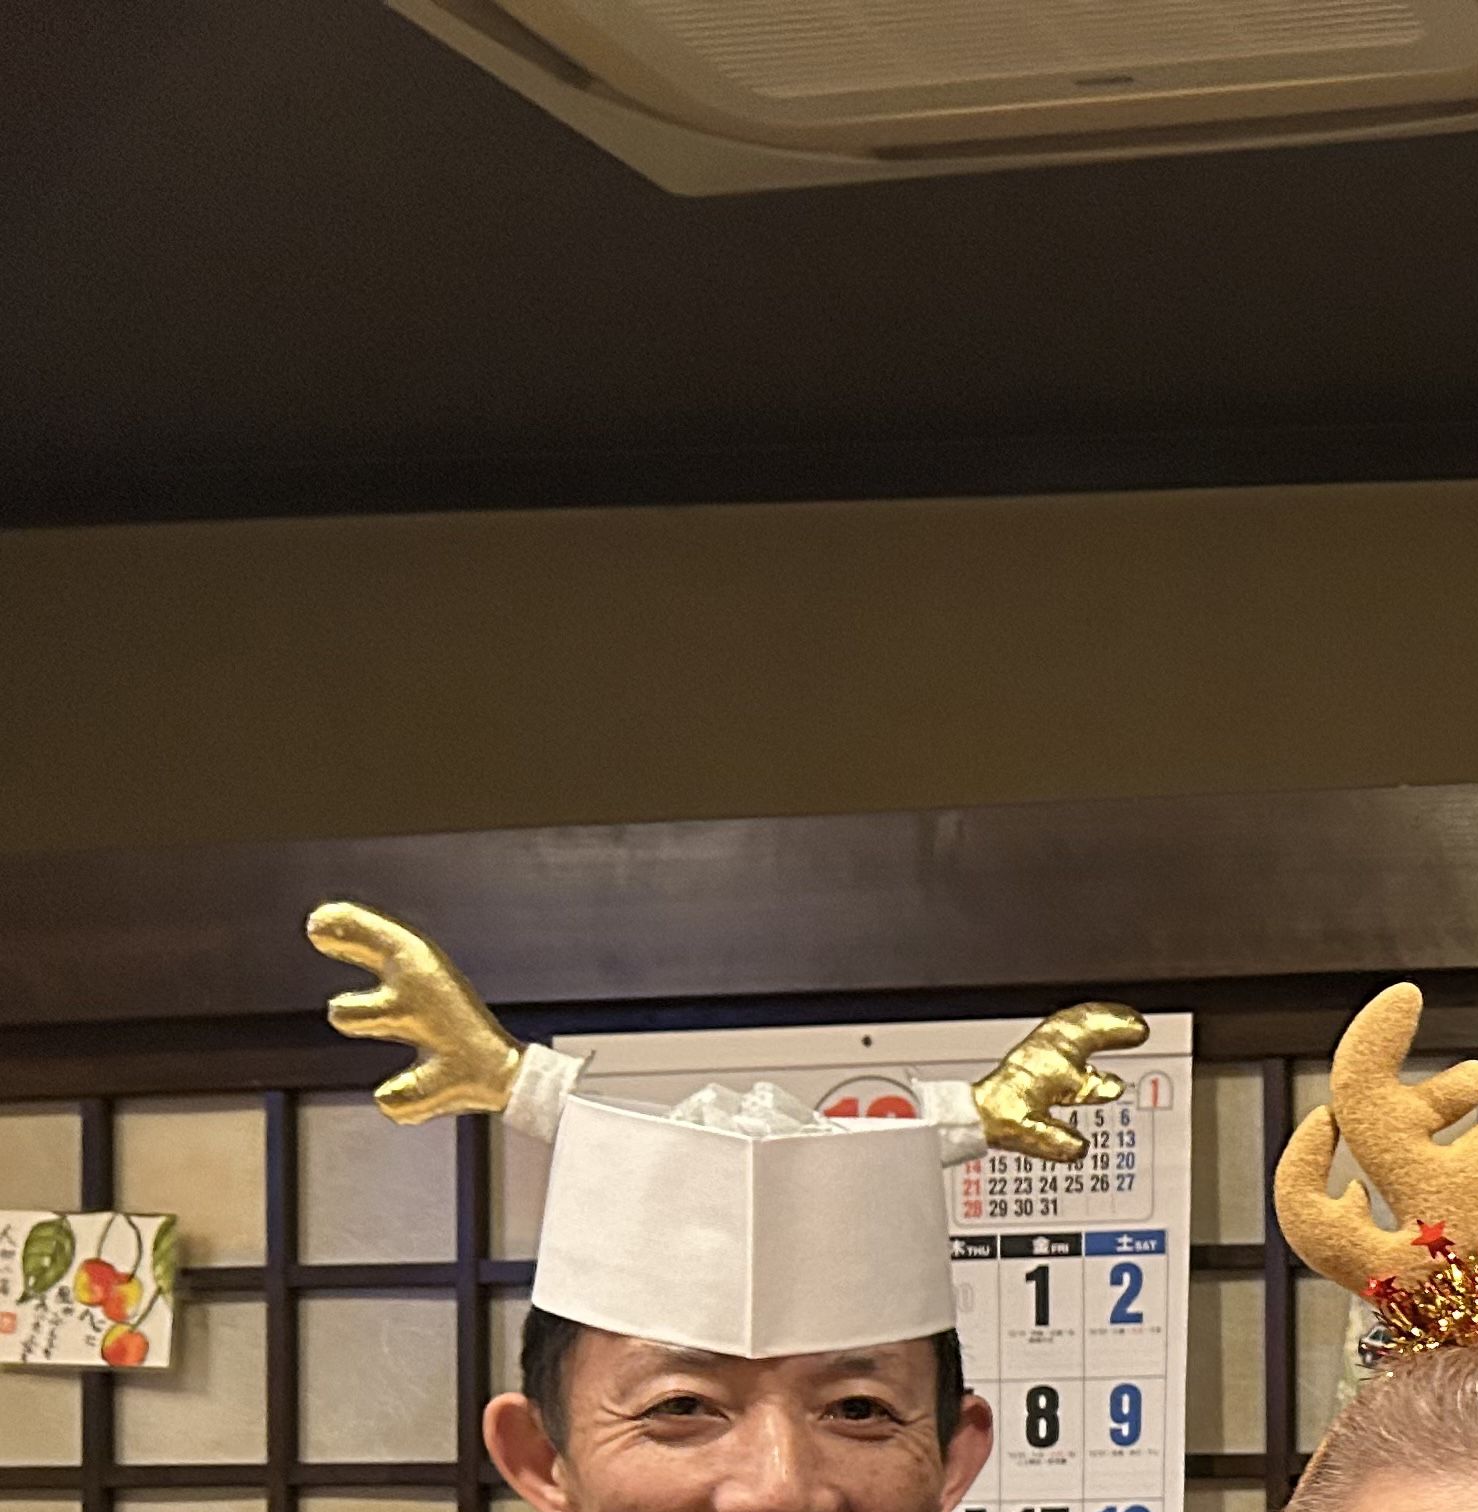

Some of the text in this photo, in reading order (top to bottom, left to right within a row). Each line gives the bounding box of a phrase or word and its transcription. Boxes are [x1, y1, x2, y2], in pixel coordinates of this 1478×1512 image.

[1150, 1077, 1160, 1109] 1
[1095, 1109, 1104, 1127] 5
[1120, 1108, 1130, 1126] 6
[1092, 1130, 1135, 1148] 12 13
[989, 1156, 1007, 1174] 15
[1015, 1157, 1032, 1173] 16
[1092, 1154, 1109, 1171] 19
[1116, 1152, 1135, 1170] 20
[963, 1174, 1135, 1196] 21 22 23 24 25 26 27
[964, 1198, 1058, 1218] 28 29 30 31
[1025, 1264, 1050, 1326] 1
[1110, 1262, 1143, 1324] 2
[1025, 1383, 1142, 1448] 8 9
